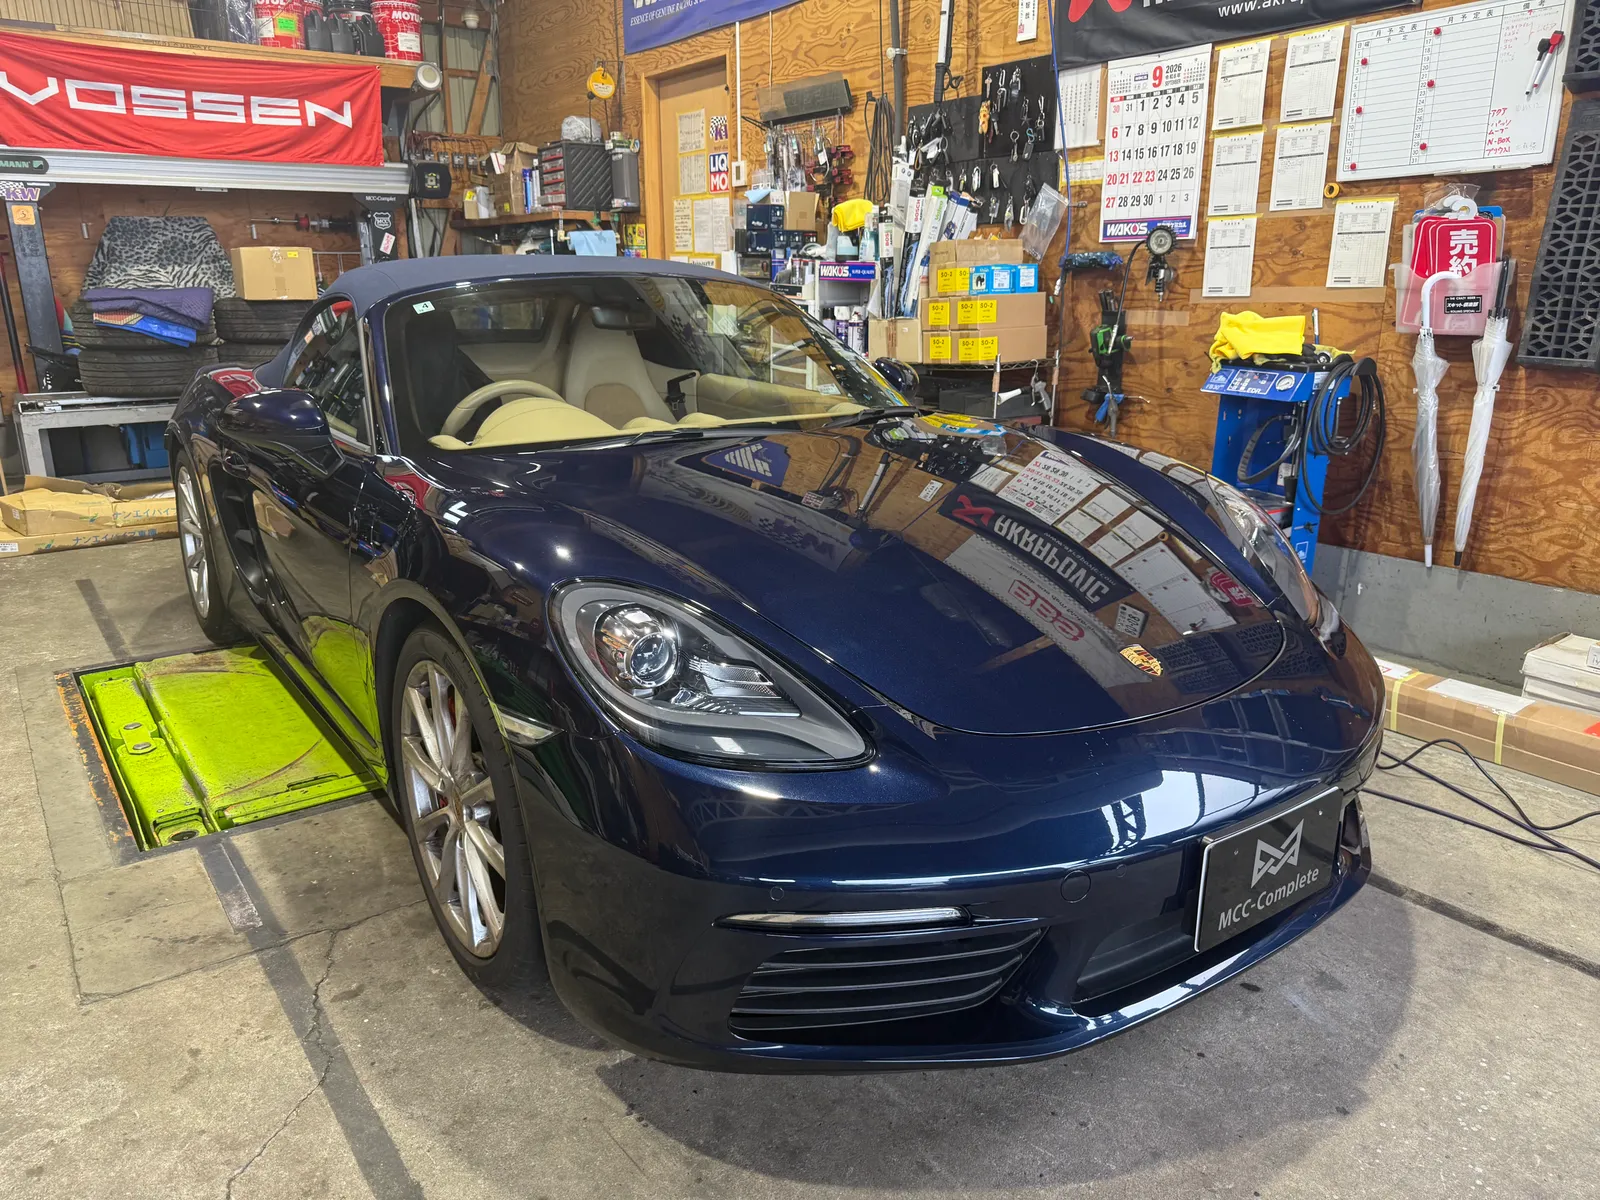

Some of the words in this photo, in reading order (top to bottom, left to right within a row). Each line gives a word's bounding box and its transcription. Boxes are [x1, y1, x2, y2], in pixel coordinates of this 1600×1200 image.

[1152, 65, 1163, 88] 9
[1165, 62, 1182, 74] 2026
[0, 71, 352, 128] VOSSEN
[1113, 105, 1120, 113] 30
[1126, 103, 1133, 112] 31
[1140, 100, 1145, 111] 1
[1153, 98, 1159, 110] 2
[1166, 96, 1172, 108] 3
[1178, 93, 1185, 105] 4
[1192, 92, 1199, 104] 5
[1112, 127, 1118, 139] 6
[1125, 126, 1132, 137] 7
[1138, 124, 1144, 136] 8
[1151, 122, 1157, 134] 9
[1163, 120, 1172, 132] 10
[1175, 118, 1184, 131] 11
[1188, 116, 1198, 130] 12
[1109, 150, 1118, 162] 13
[1122, 149, 1131, 161] 14
[1135, 148, 1144, 160] 15
[1148, 146, 1157, 158] 16
[1160, 145, 1170, 157] 17
[1173, 143, 1182, 156] 18
[1186, 142, 1196, 154] 19
[710, 154, 728, 172] LIQ
[711, 173, 728, 191] MO
[1107, 174, 1117, 185] 20
[1120, 173, 1129, 184] 21
[1132, 172, 1142, 183] 22
[1145, 170, 1155, 182] 23
[1158, 169, 1168, 181] 24
[1170, 168, 1180, 180] 25
[1183, 167, 1194, 179] 26
[5, 187, 40, 201] KW
[1106, 197, 1115, 208] 27
[1118, 196, 1128, 207] 28
[1131, 195, 1140, 206] 29
[1143, 194, 1154, 206] 30
[1449, 228, 1478, 278] 売約
[1218, 868, 1319, 930] MCC-Complete
